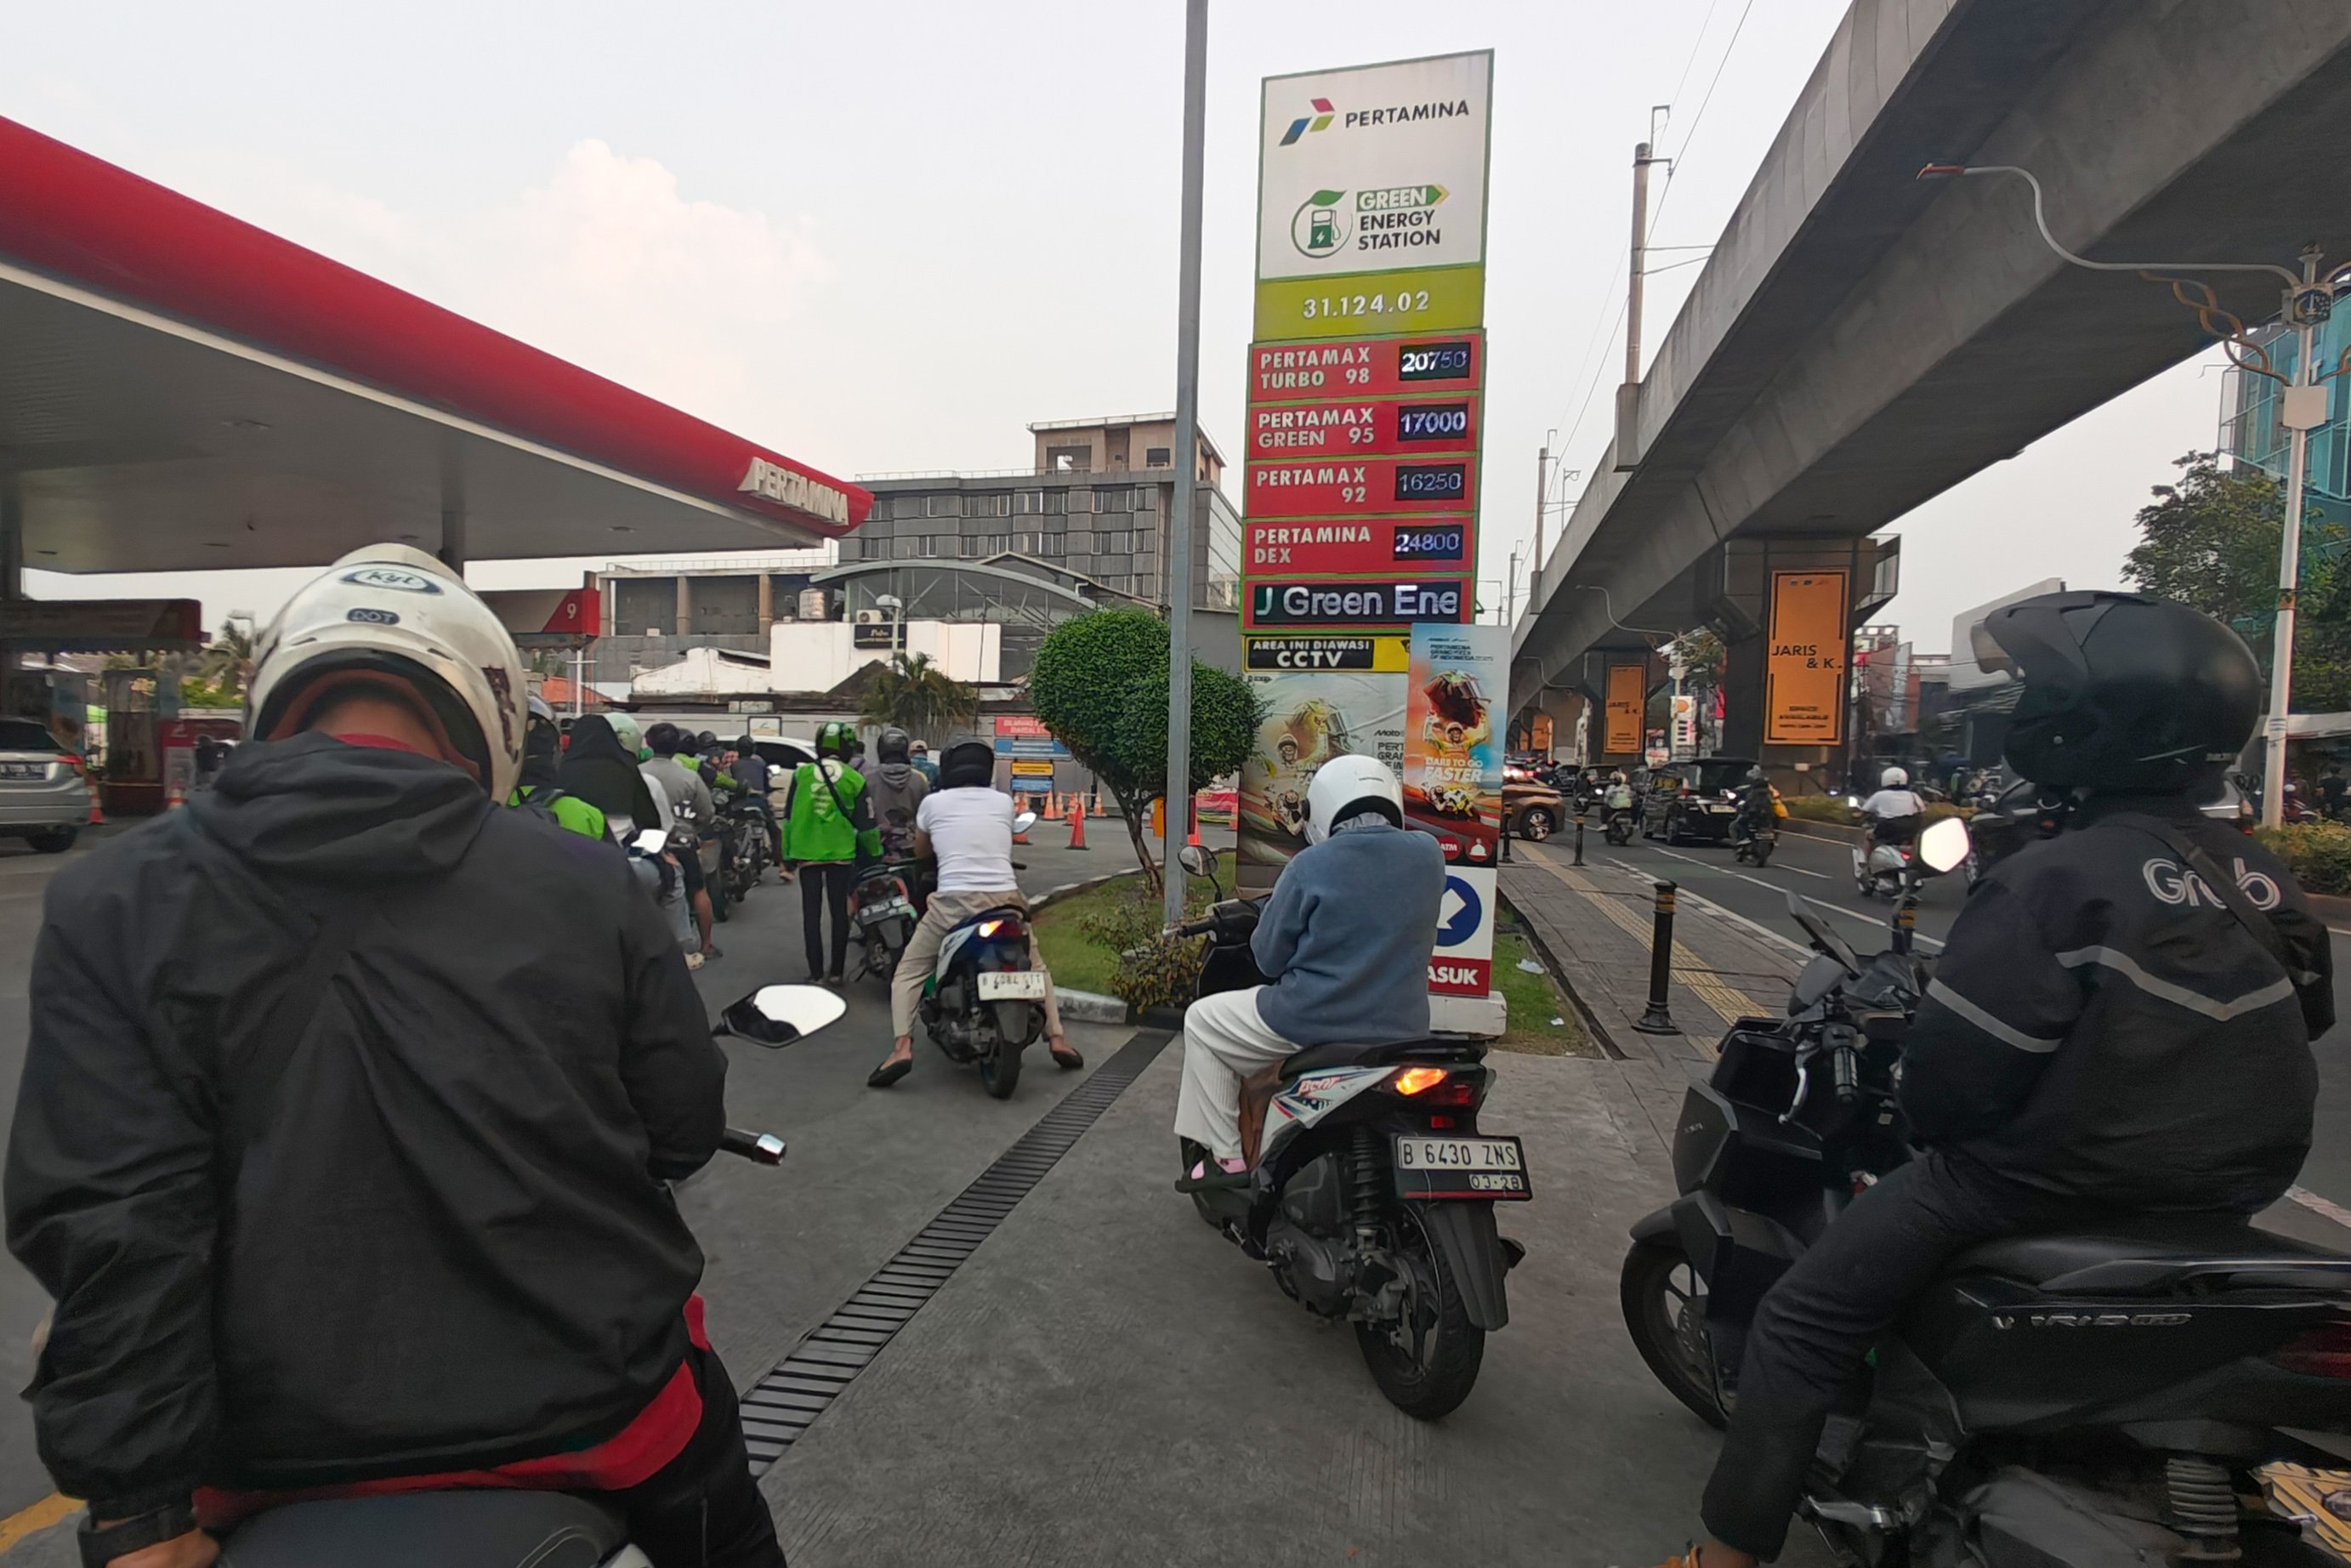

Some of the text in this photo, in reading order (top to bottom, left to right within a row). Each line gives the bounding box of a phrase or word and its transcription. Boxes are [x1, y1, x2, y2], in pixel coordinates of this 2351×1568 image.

[1345, 99, 1470, 128] PERTAMINA
[1359, 187, 1428, 211] GREEN
[1360, 209, 1436, 231] ENERGY
[1358, 229, 1440, 251] STATION
[1303, 290, 1429, 319] 31.124.02
[1260, 346, 1468, 372] PERTAMAX 20750
[1261, 368, 1370, 389] TURBO 98
[1258, 407, 1466, 434] PERTAMAX 17000
[1258, 427, 1375, 447] GREEN 95
[1257, 466, 1462, 491] PERTAMAX 16250
[736, 457, 849, 526] PERTAMINA
[1342, 487, 1366, 503] 92
[1254, 526, 1459, 552] PERTAMINA 24800
[1254, 548, 1292, 564] DEX
[1283, 586, 1383, 616] Green
[1394, 585, 1458, 615] Ene
[351, 611, 393, 623] DOT
[567, 603, 576, 619] 9
[1253, 640, 1370, 650] AREA INI DIAWASI
[1771, 645, 1817, 656] JARIS
[1276, 650, 1343, 668] CCTV
[1807, 658, 1818, 668] &
[1378, 741, 1404, 751] PERT
[1424, 766, 1483, 782] FASTER
[1440, 843, 1457, 851] ATM
[1428, 966, 1479, 986] ASUK
[1403, 1143, 1516, 1166] B 6430 ZNS
